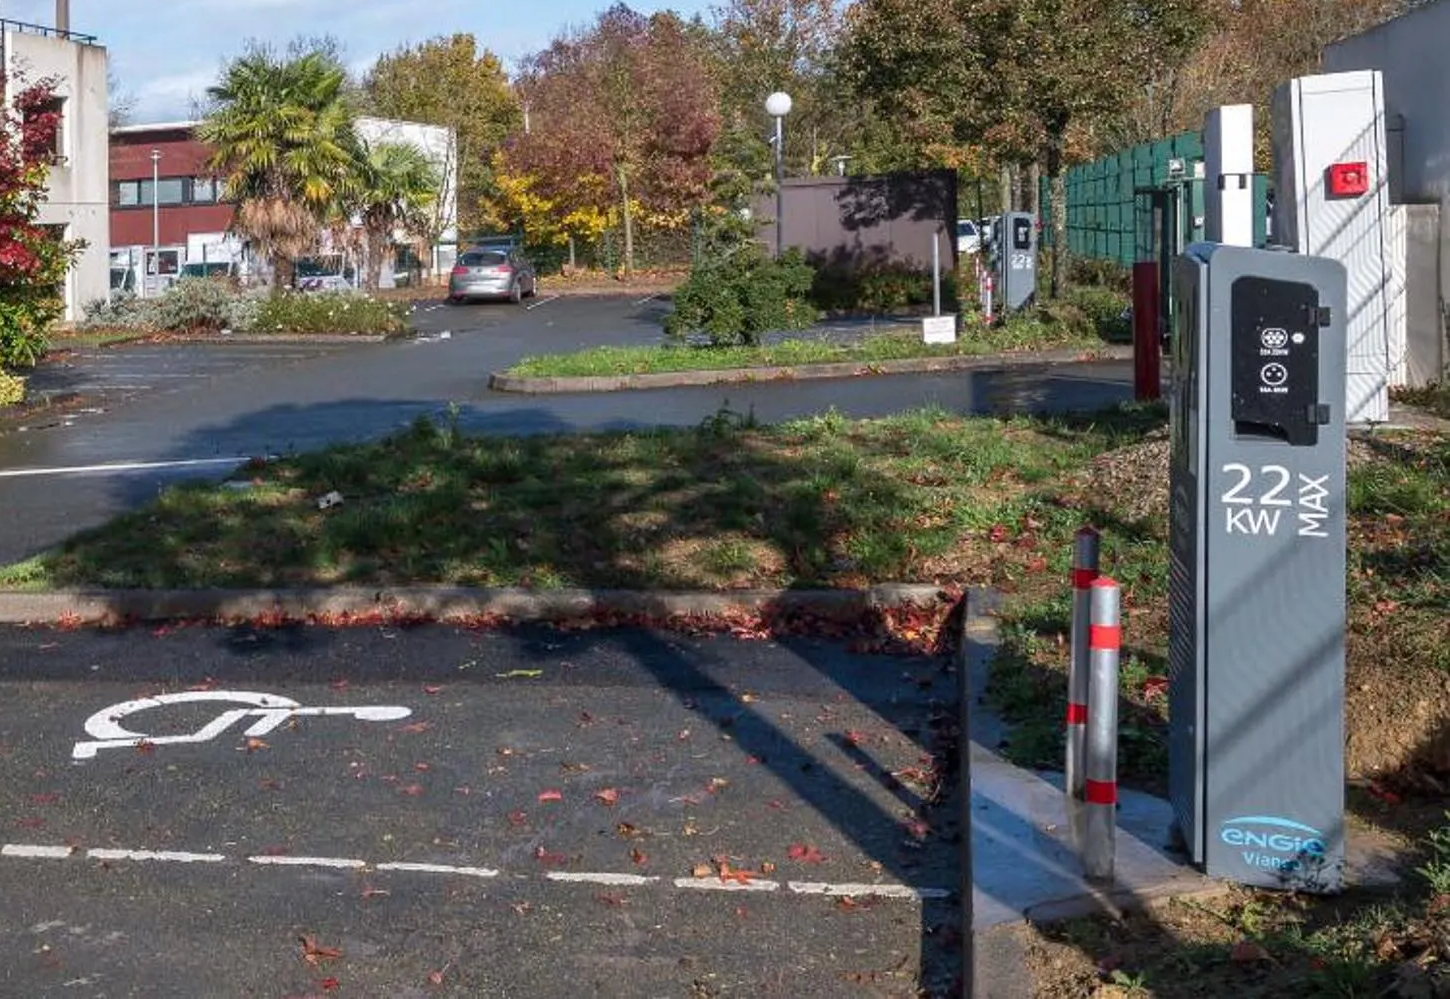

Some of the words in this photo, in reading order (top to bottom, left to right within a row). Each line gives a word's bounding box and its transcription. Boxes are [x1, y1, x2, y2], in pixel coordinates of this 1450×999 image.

[1221, 463, 1293, 507] 22
[1226, 507, 1281, 536] KW
[1299, 473, 1329, 538] MAX
[1242, 851, 1302, 871] Vian
